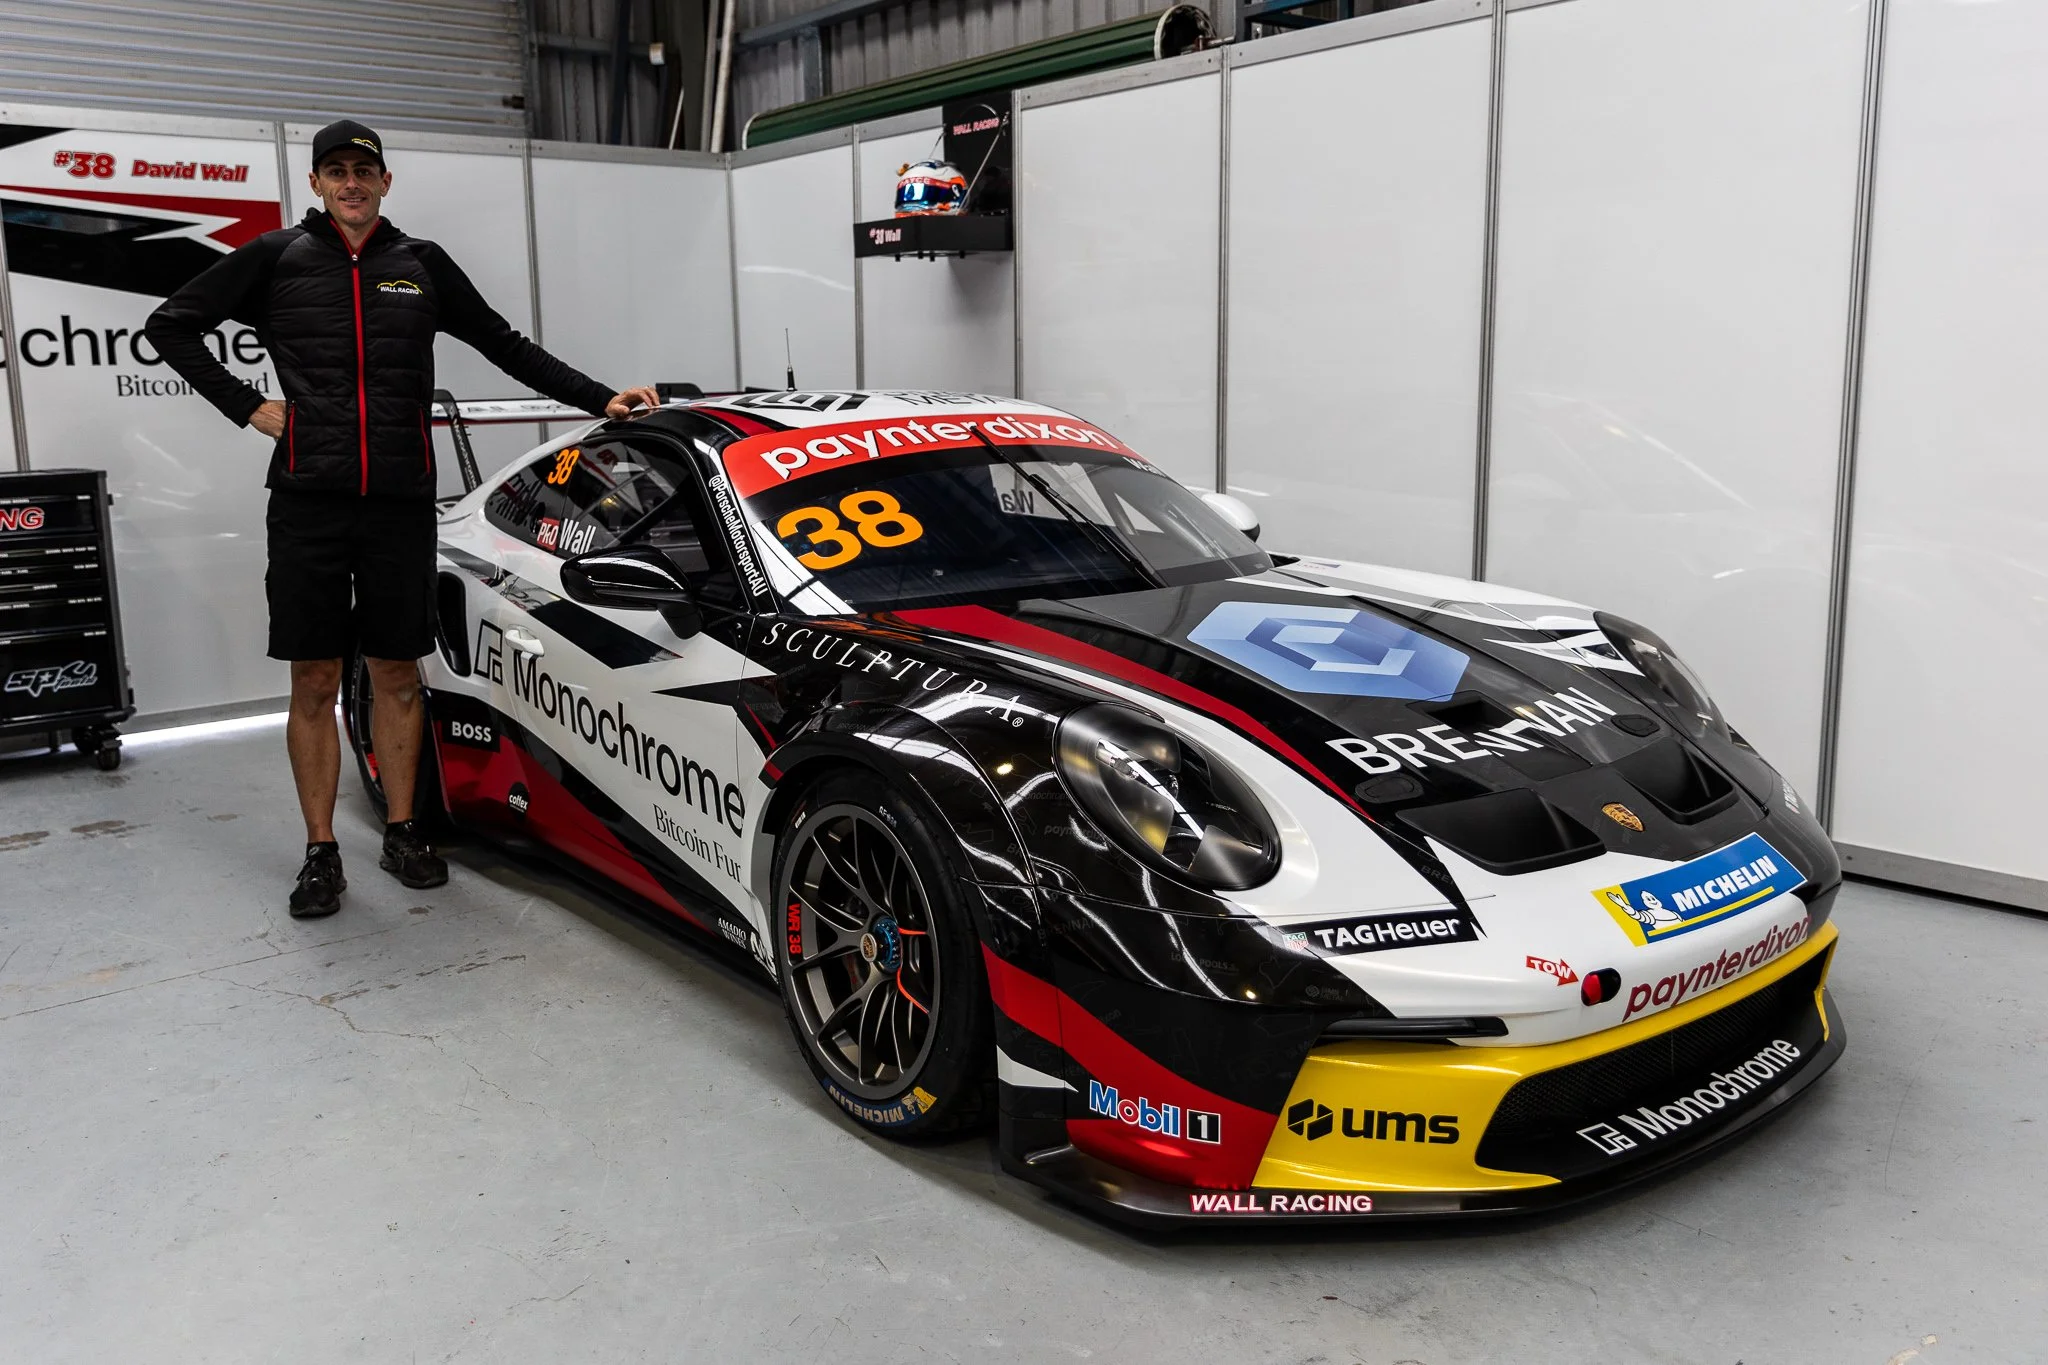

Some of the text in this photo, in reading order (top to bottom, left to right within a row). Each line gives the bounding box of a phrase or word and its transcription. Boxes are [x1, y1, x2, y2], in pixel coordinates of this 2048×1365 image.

[53, 150, 249, 183] #38 David Wall
[397, 287, 419, 295] RACING
[547, 448, 580, 486] 38
[537, 518, 597, 555] PRO Wall
[708, 474, 769, 598] @PorscheMotorsportAU
[776, 489, 924, 571] 38
[451, 720, 492, 743] BOSS
[514, 650, 746, 838] Monochrome
[652, 803, 712, 864] Bitcoin
[1671, 855, 1779, 913] MICHELIN
[717, 917, 747, 941] AMADIO
[787, 903, 802, 955] WR 38
[1528, 958, 1572, 980] TOW
[1622, 914, 1811, 1023] paynterdixon
[828, 1084, 905, 1123] MICHELIN
[1617, 1038, 1801, 1140] Monochrome
[1088, 1080, 1181, 1139] Mobil
[1341, 1108, 1460, 1145] ums
[1190, 1193, 1373, 1215] WALL RACING
